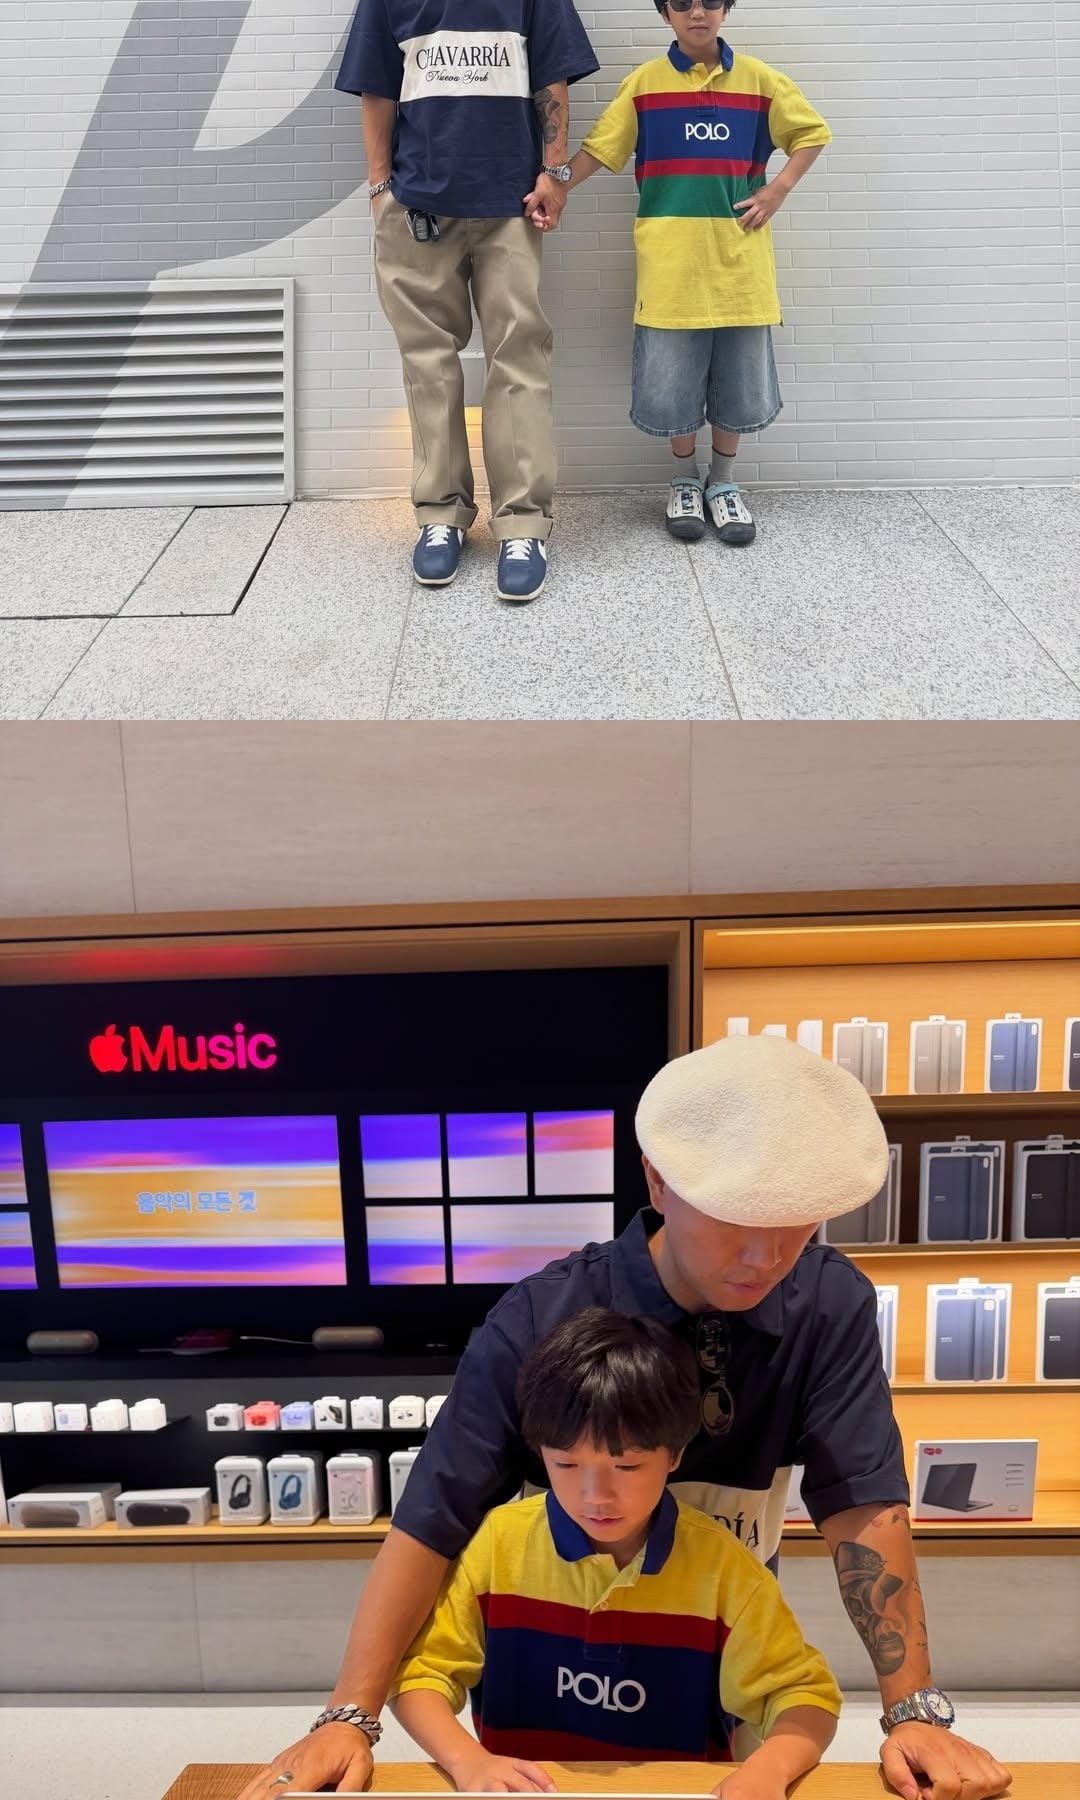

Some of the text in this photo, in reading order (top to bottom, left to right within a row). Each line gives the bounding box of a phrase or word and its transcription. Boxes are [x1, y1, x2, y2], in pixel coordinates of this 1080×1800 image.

[416, 42, 512, 70] CHAVARRÍA
[425, 69, 489, 85] Nueva York
[685, 122, 730, 141] POLO
[129, 1022, 278, 1072] Music
[137, 1191, 192, 1214] 음악의
[197, 1191, 233, 1213] 모든
[557, 1665, 647, 1713] POLO
